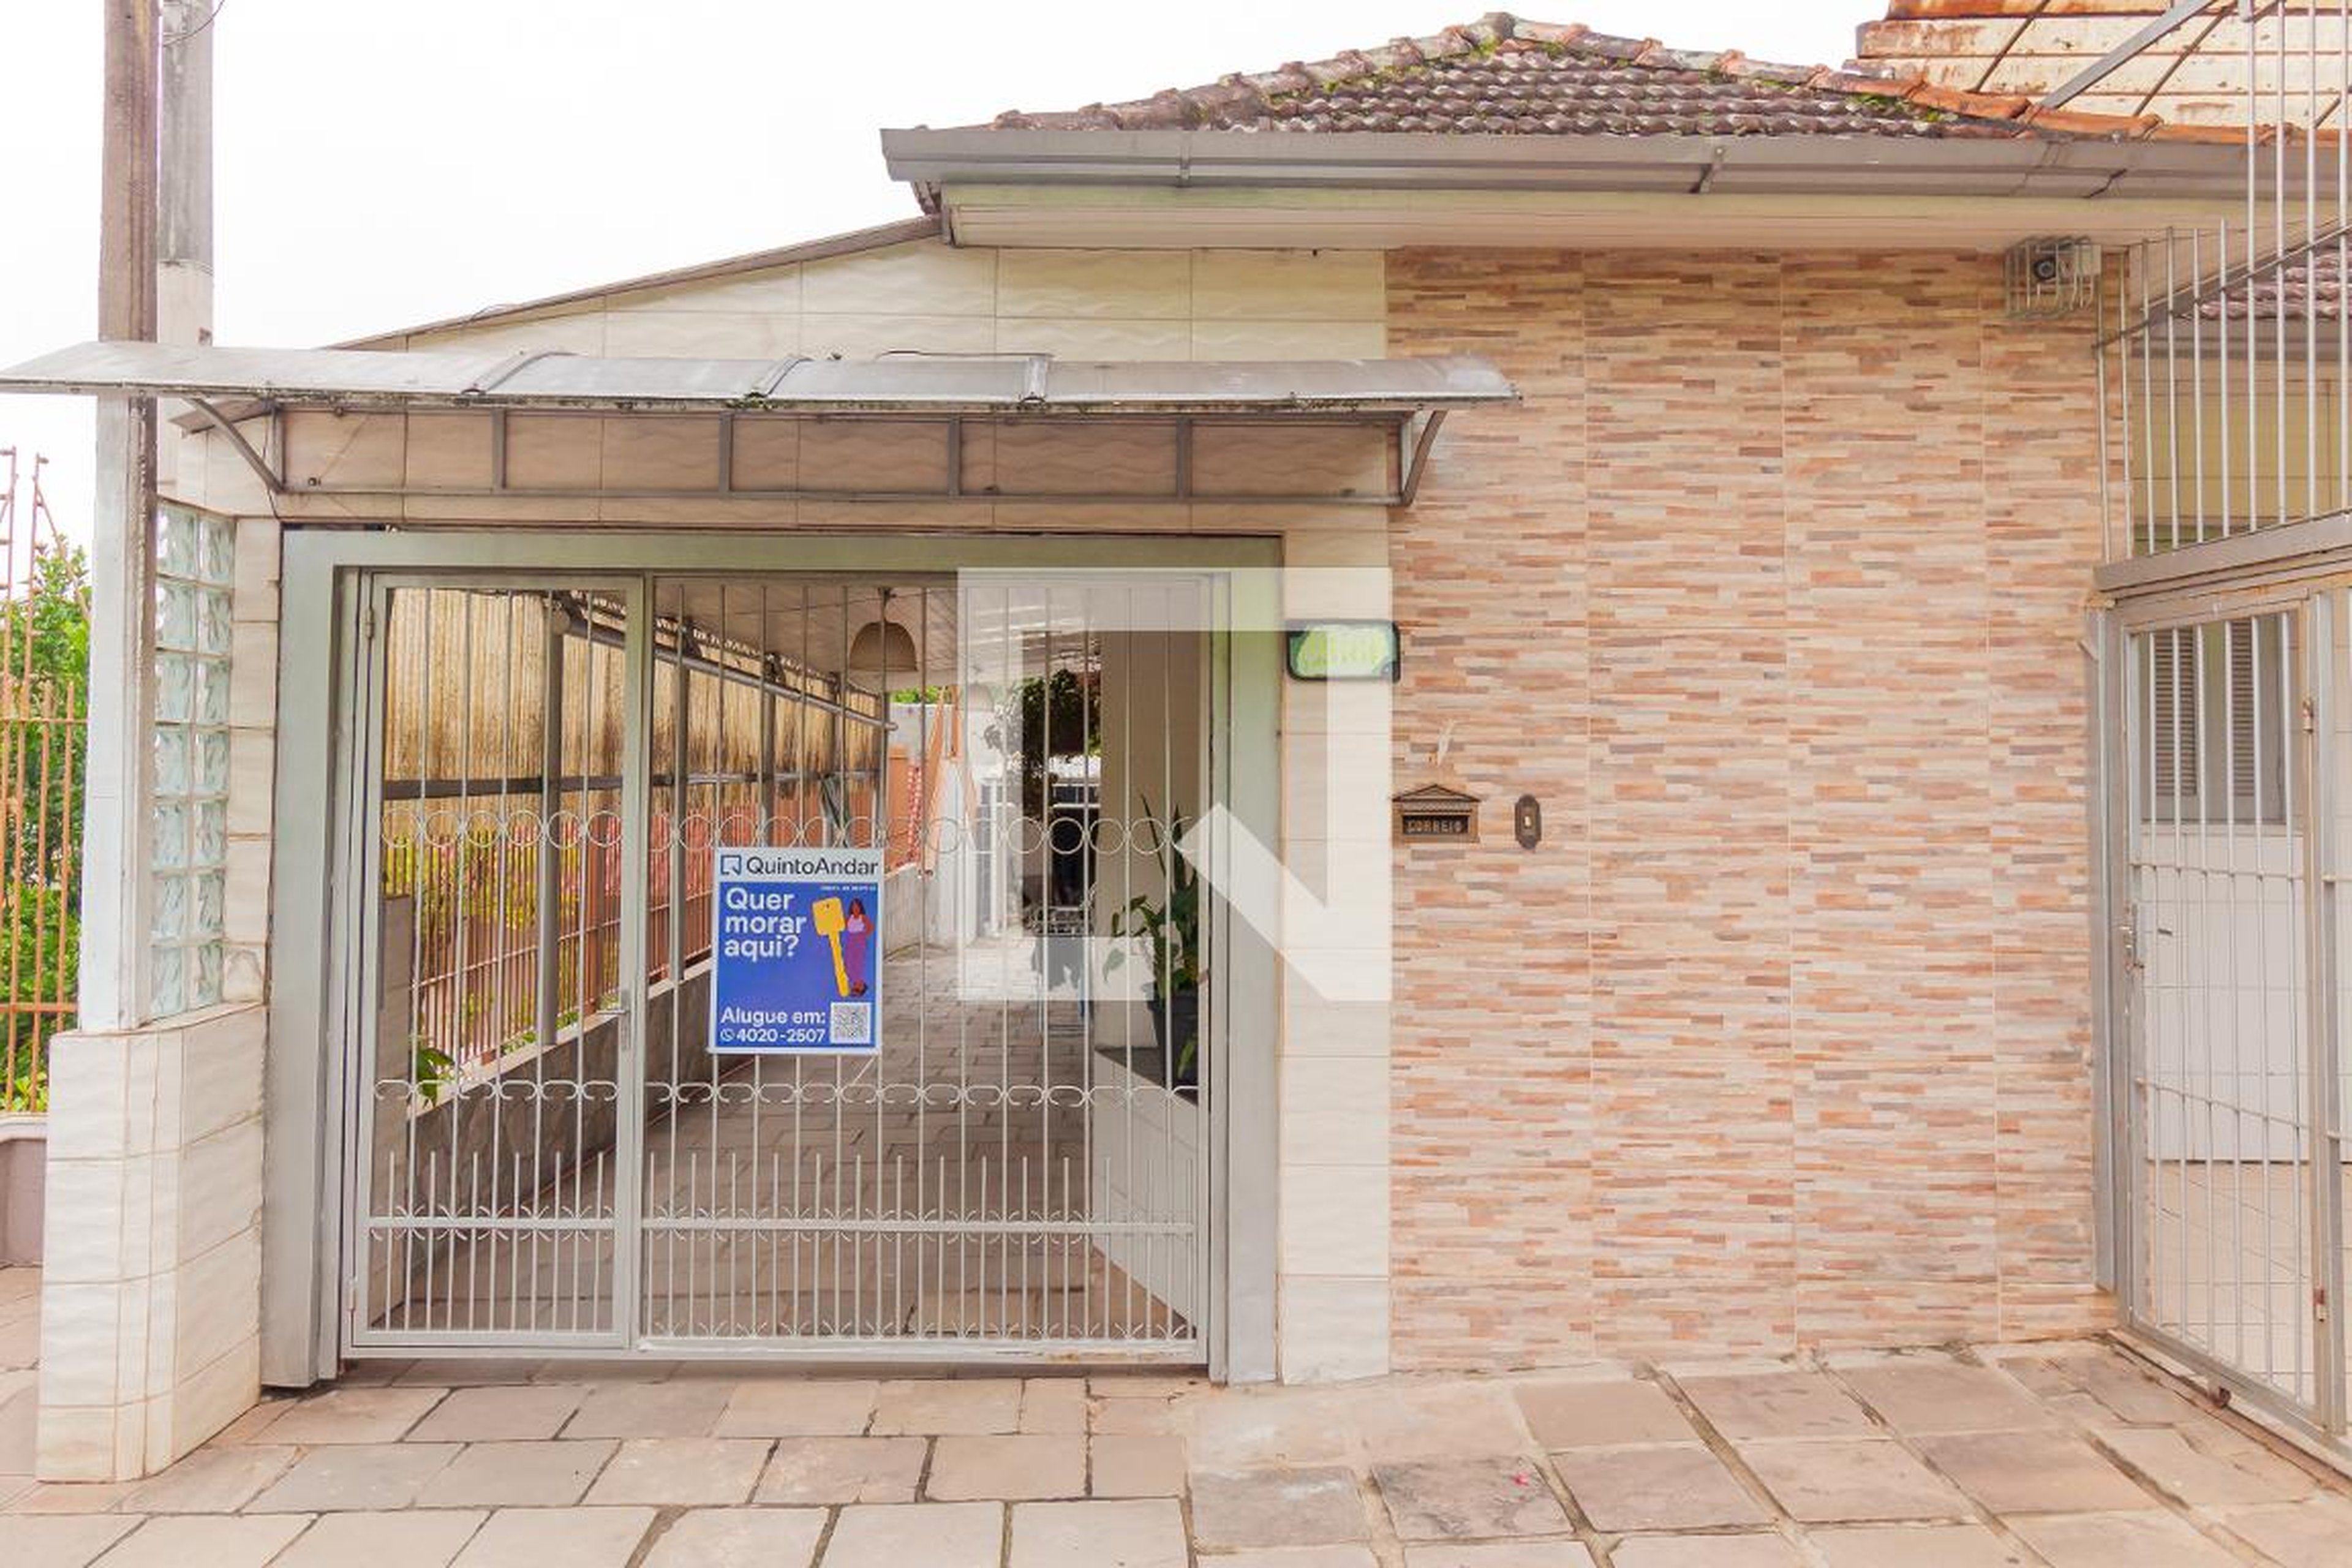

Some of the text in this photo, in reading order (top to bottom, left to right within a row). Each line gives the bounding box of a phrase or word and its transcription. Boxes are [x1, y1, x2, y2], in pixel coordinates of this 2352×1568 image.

[747, 858, 878, 875] QuintoAndar
[726, 888, 794, 910] Quer
[725, 916, 807, 933] morar
[724, 935, 799, 962] aqui?
[720, 1008, 826, 1027] Alugue em:
